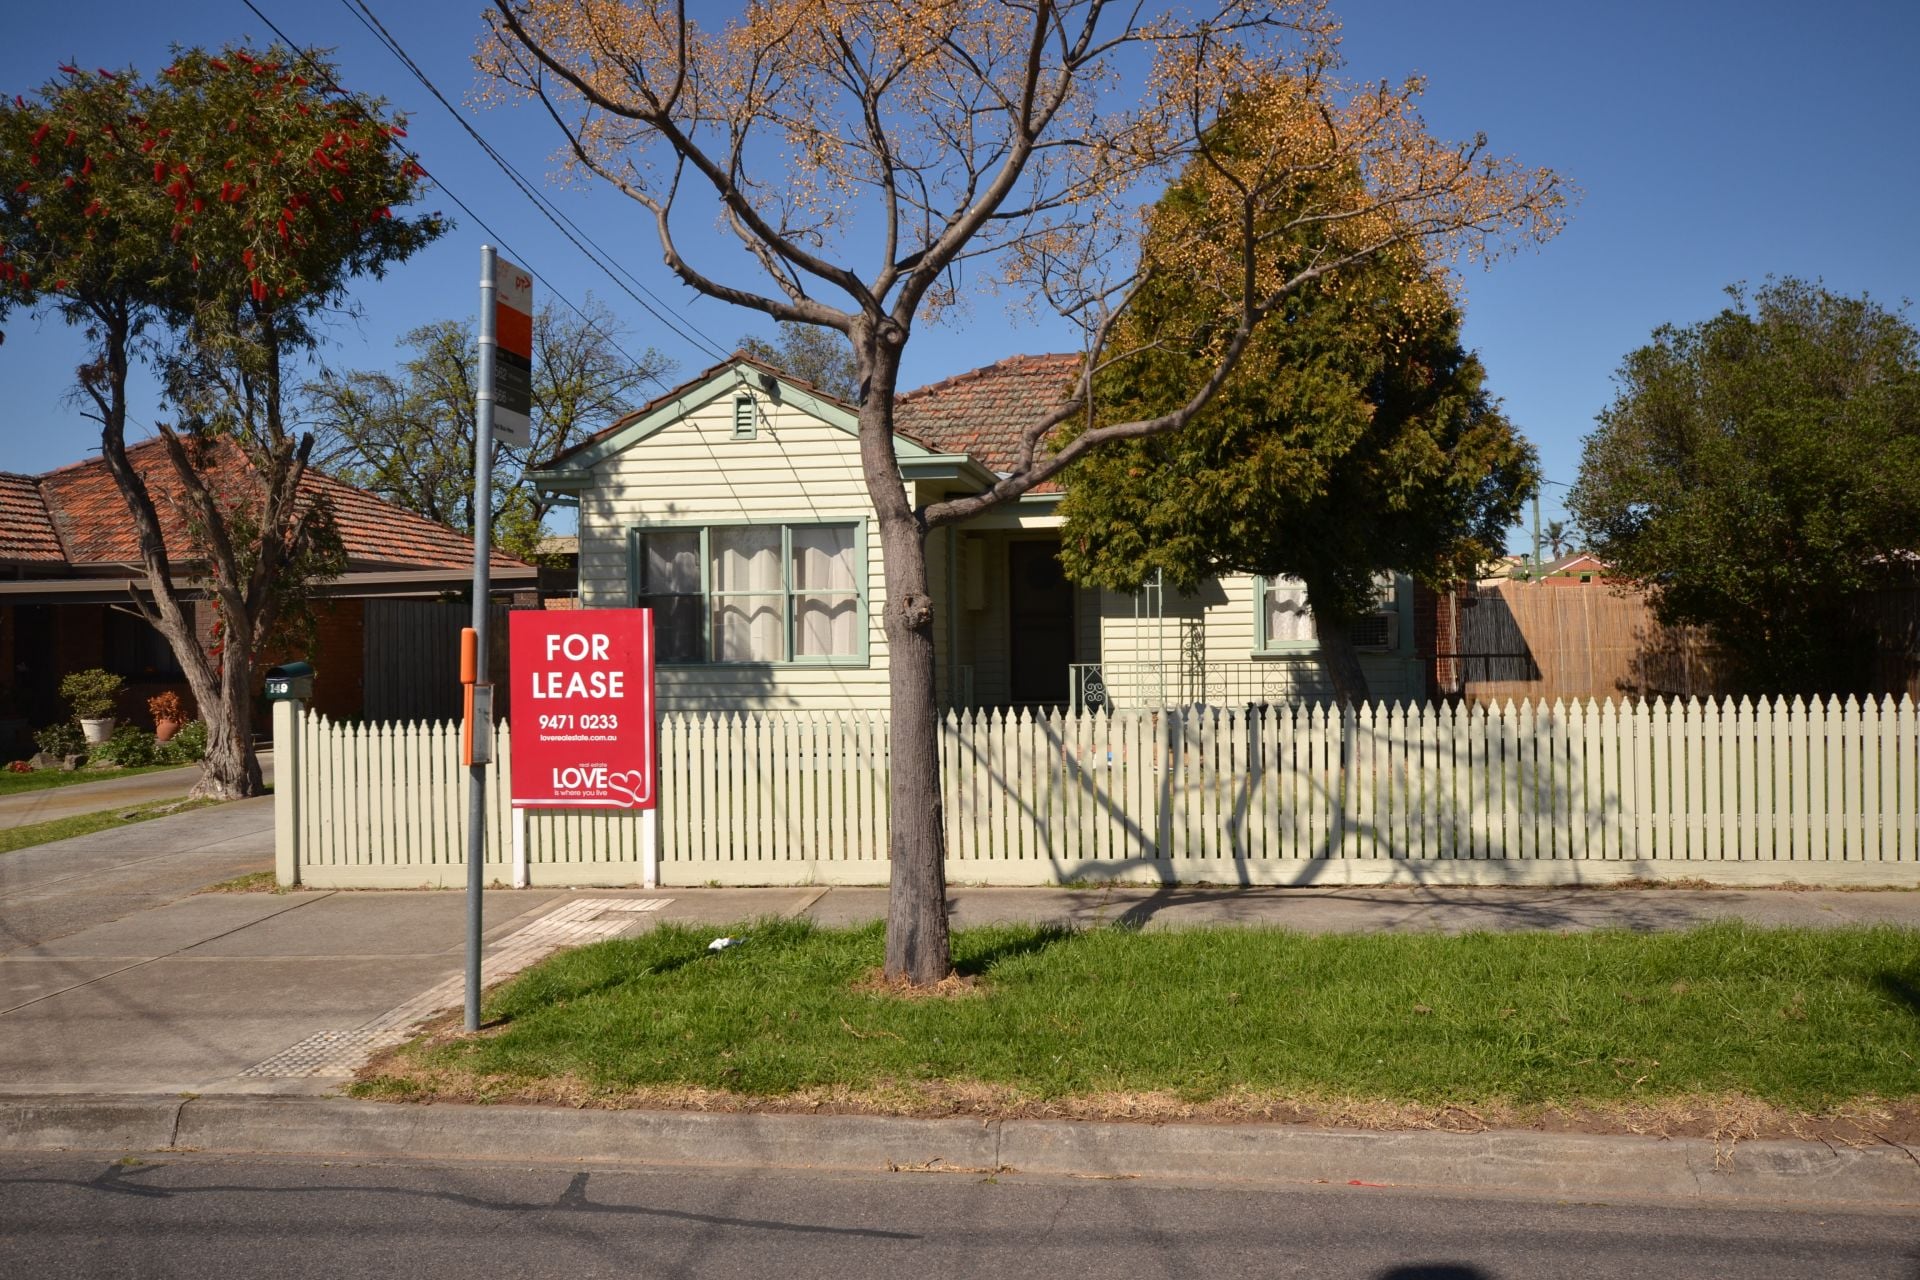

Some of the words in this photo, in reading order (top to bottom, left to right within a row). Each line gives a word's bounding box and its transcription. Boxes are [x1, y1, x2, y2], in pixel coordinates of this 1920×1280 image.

[546, 634, 610, 661] FOR
[532, 671, 624, 699] LEASE
[539, 714, 574, 729] 9471
[580, 714, 618, 729] 0233
[552, 767, 608, 788] LOVE
[582, 790, 595, 798] you
